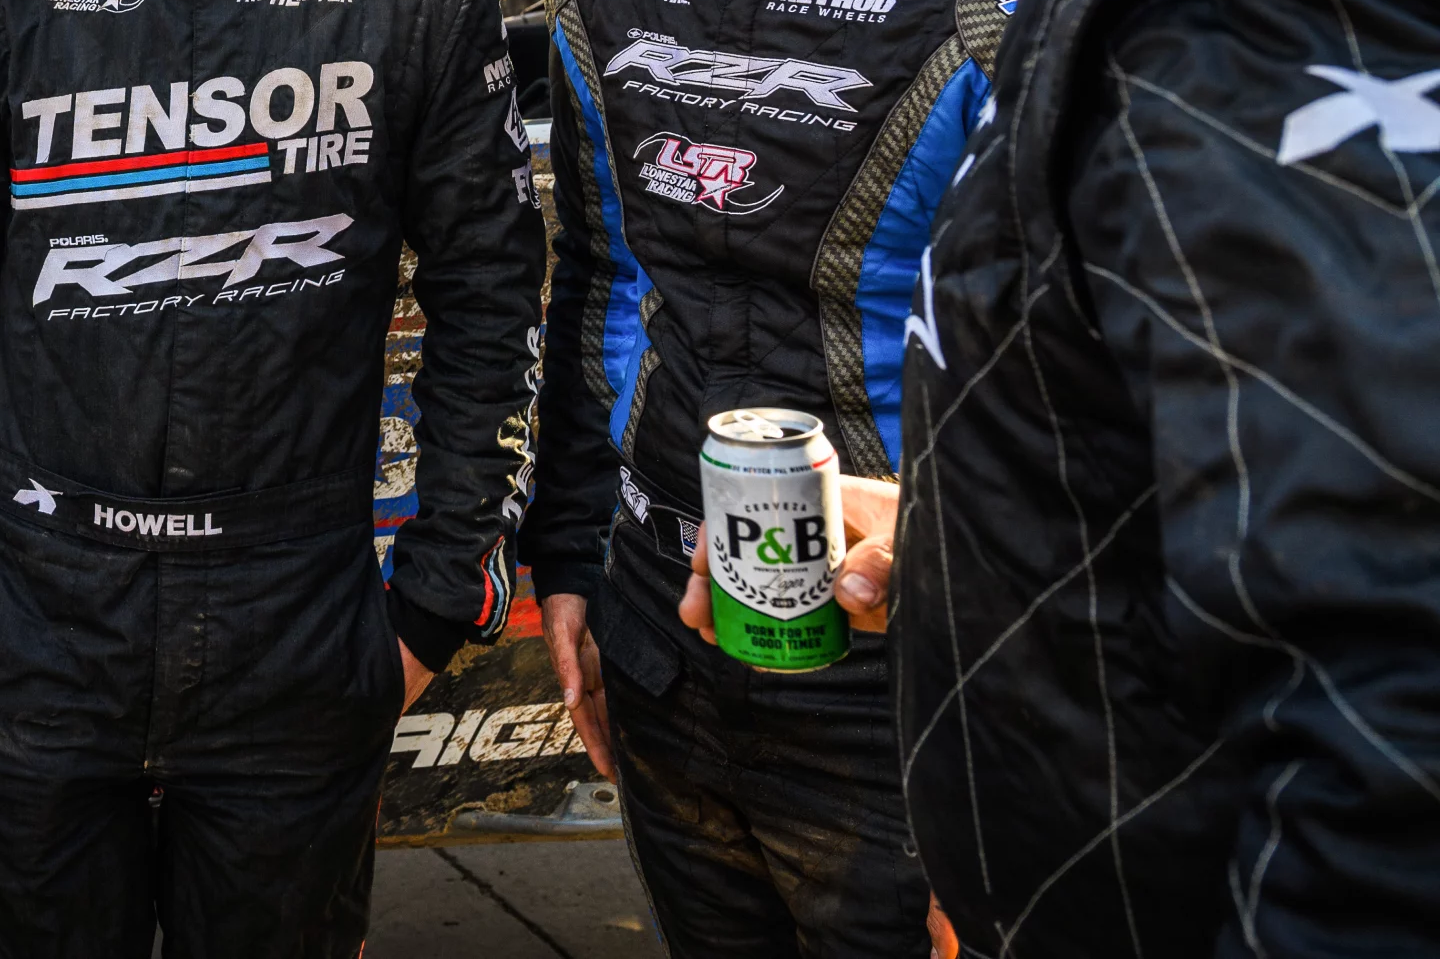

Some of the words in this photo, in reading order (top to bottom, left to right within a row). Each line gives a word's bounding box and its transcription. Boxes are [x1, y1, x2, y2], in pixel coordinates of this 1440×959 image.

[53, 1, 97, 12] RACING
[766, 1, 809, 14] RACE
[818, 6, 887, 23] WHEELS
[642, 31, 675, 45] POLARIS
[603, 39, 874, 112] RZR
[21, 59, 376, 164] TENSOR
[622, 80, 736, 110] FACTORY
[740, 101, 858, 132] RACING
[276, 129, 375, 175] TIRE
[657, 137, 756, 184] LSR
[640, 163, 698, 192] LONESTAR
[647, 179, 696, 204] RACING
[49, 234, 105, 247] POLARIS
[32, 213, 356, 308] RZR
[47, 292, 202, 321] FACTORY
[212, 269, 346, 305] RACING
[93, 503, 223, 537] HOWELL
[744, 501, 808, 513] CERVEZA
[725, 512, 829, 565] P&B
[759, 573, 805, 598] Lager
[744, 622, 776, 638] BORN
[779, 626, 803, 638] FOR
[751, 636, 783, 650] GOOD
